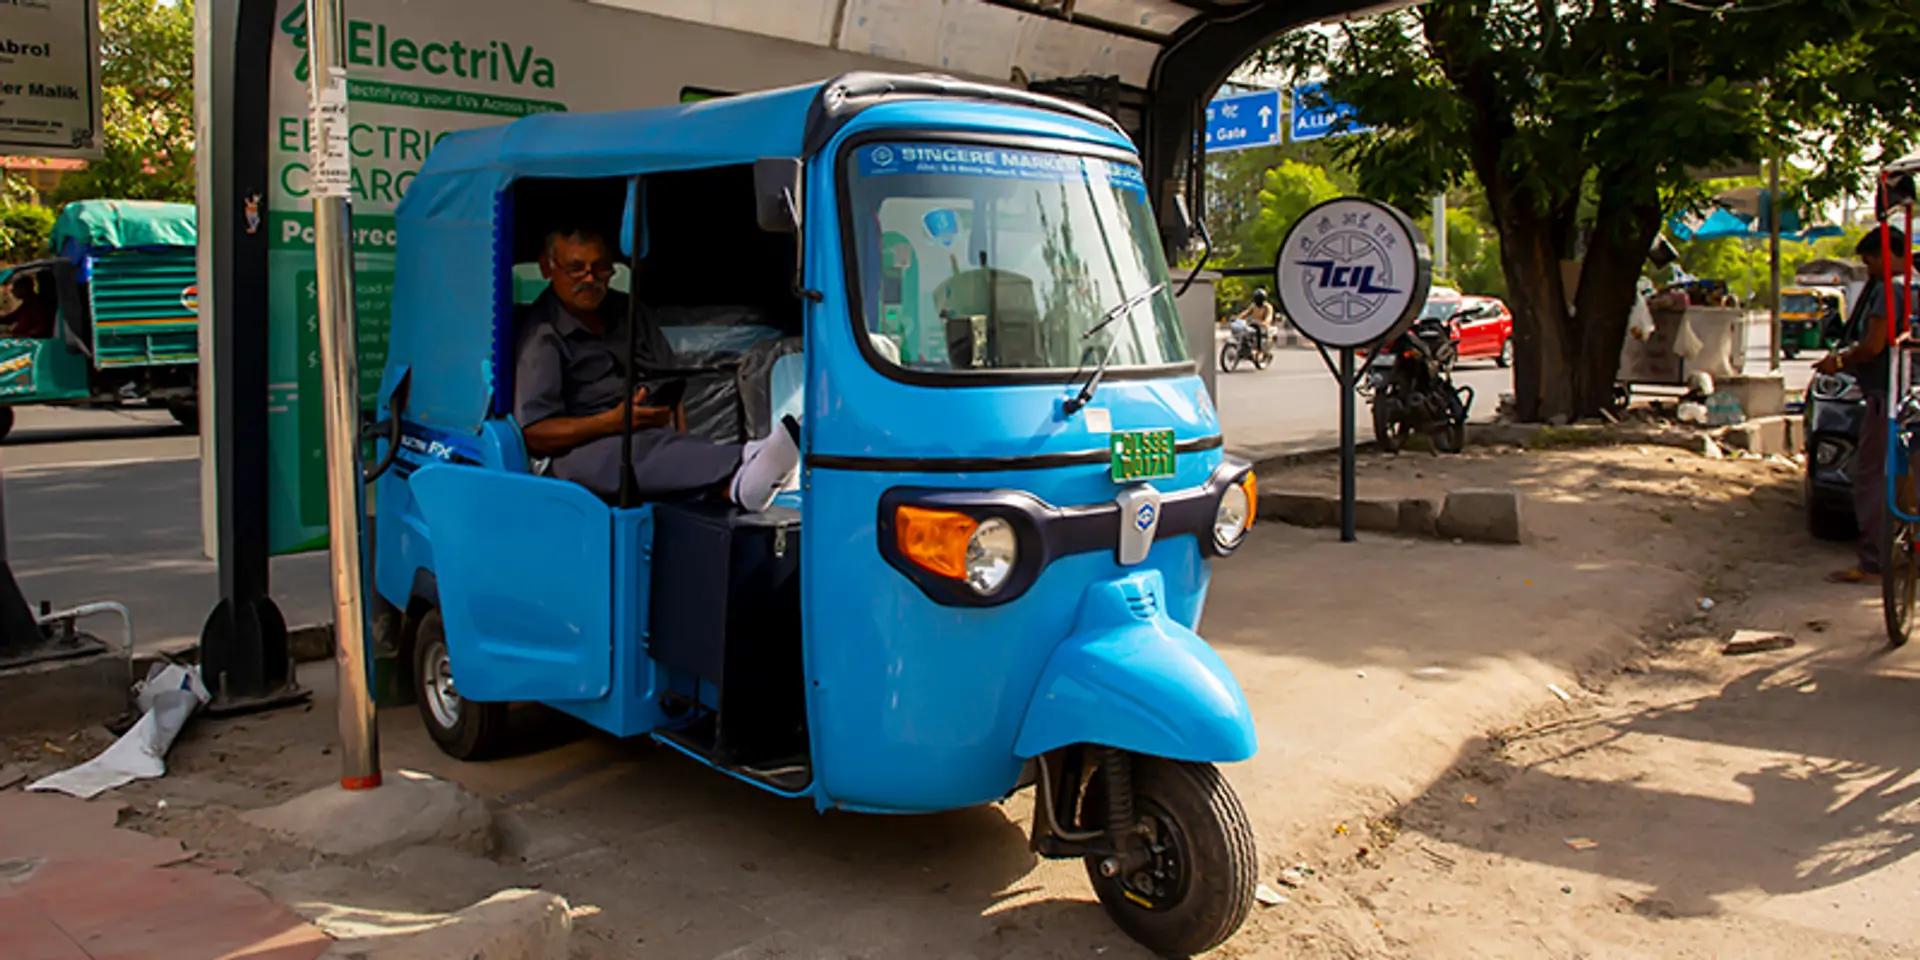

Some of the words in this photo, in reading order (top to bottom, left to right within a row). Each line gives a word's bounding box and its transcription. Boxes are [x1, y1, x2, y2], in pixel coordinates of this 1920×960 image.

[348, 20, 555, 89] ElectriVa
[29, 83, 80, 100] Malik
[349, 82, 419, 105] lectrifying
[423, 91, 452, 107] your
[456, 93, 479, 109] EVs
[482, 98, 524, 115] Across
[1217, 127, 1247, 142] Gate
[902, 147, 996, 165] SINCERE
[1294, 260, 1404, 294] TCIL
